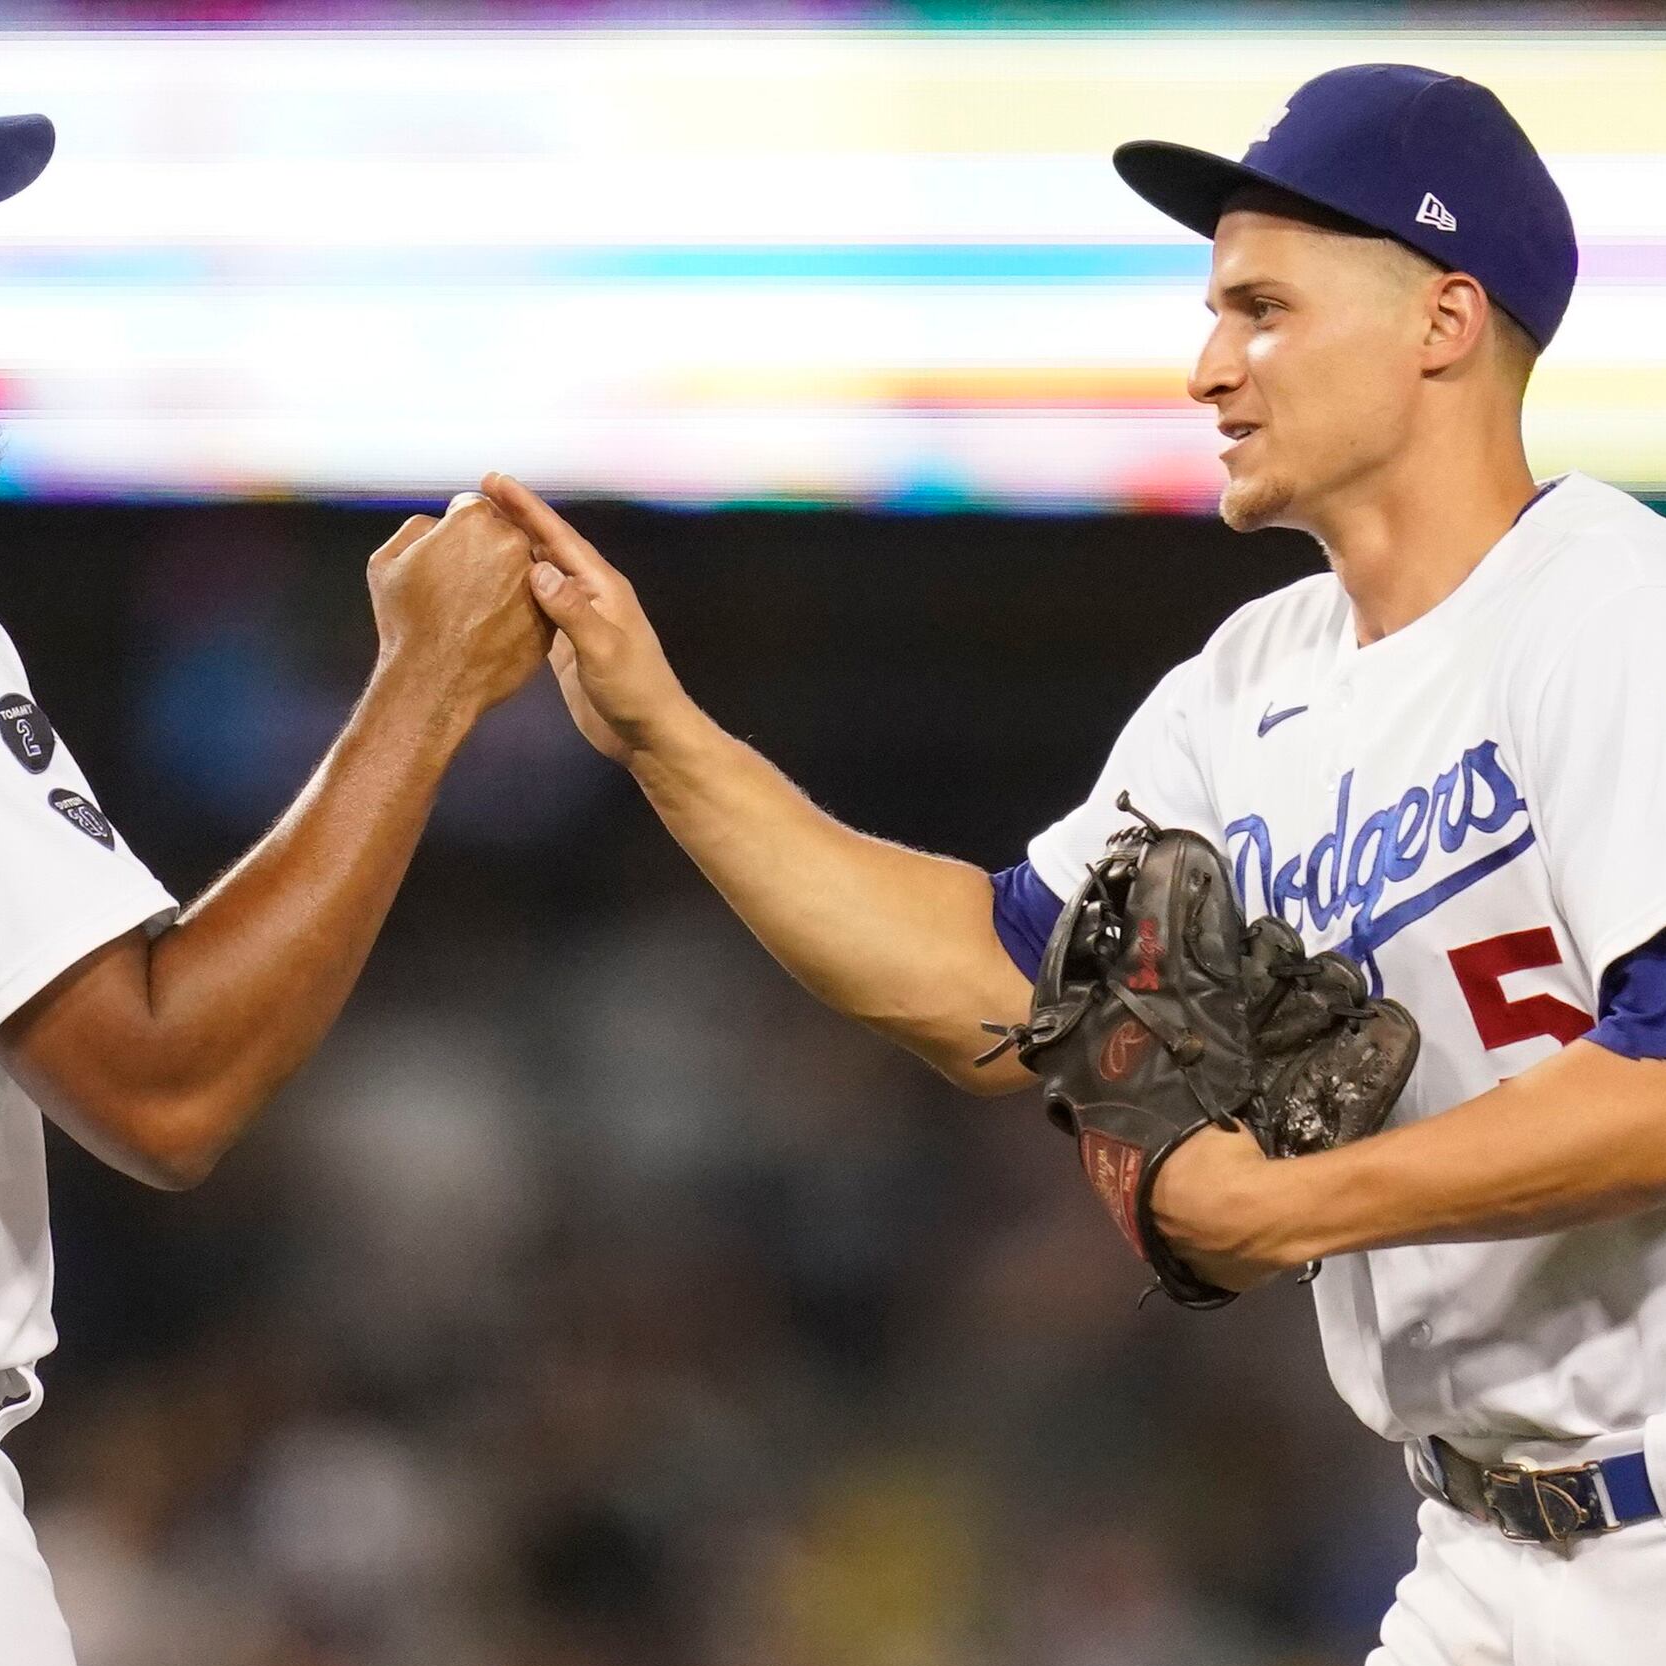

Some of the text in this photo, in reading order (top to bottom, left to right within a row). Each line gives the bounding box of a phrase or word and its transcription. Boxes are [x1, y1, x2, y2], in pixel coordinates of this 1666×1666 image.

[0, 704, 33, 721] TOMMY
[16, 718, 42, 757] 2
[1224, 739, 1536, 1000] Dodgers
[1447, 926, 1596, 1083] 5
